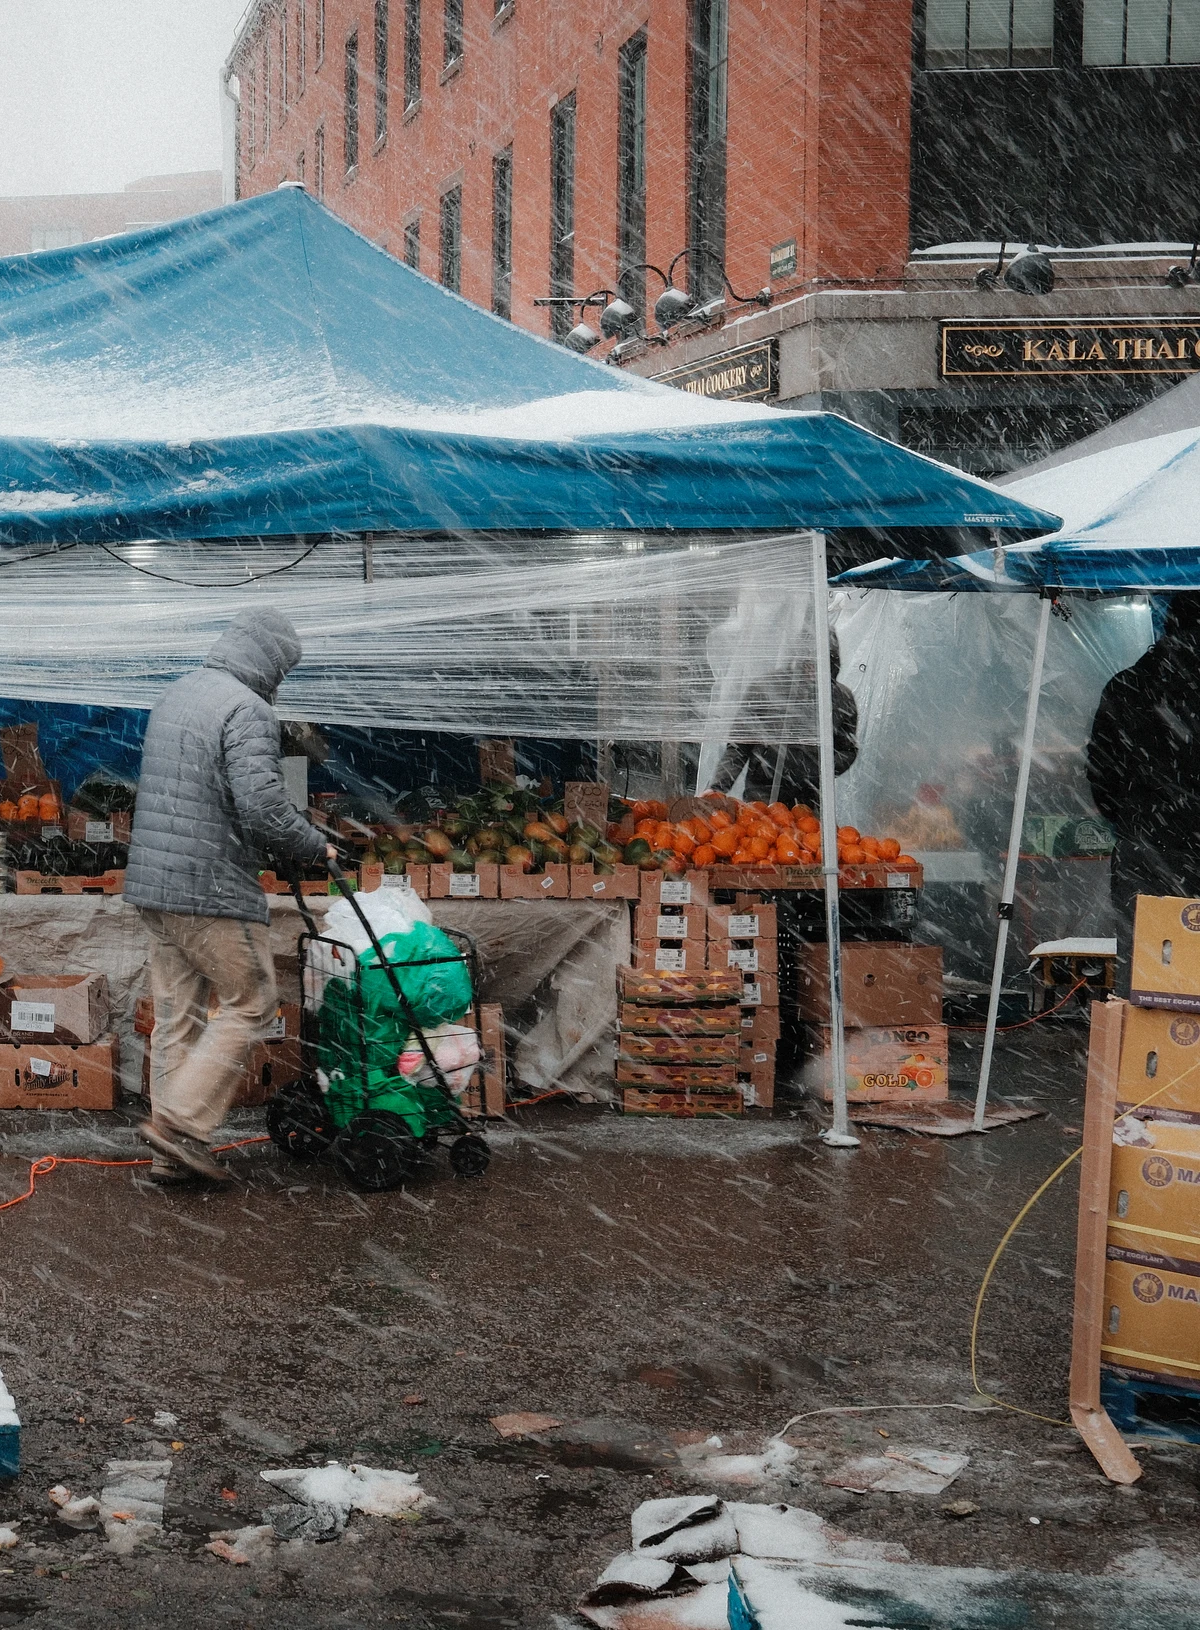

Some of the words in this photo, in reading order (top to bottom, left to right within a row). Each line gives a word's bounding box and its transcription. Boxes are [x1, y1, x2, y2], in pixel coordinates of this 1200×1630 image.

[1022, 339, 1107, 361] KALA
[1113, 337, 1188, 360] THAI
[685, 377, 705, 396] THAI
[705, 364, 748, 395] COOKERY
[1138, 995, 1153, 1003] THE
[863, 1073, 910, 1088] GOLD
[1127, 1251, 1164, 1263] EGGPLANT
[1168, 1284, 1200, 1303] MA
